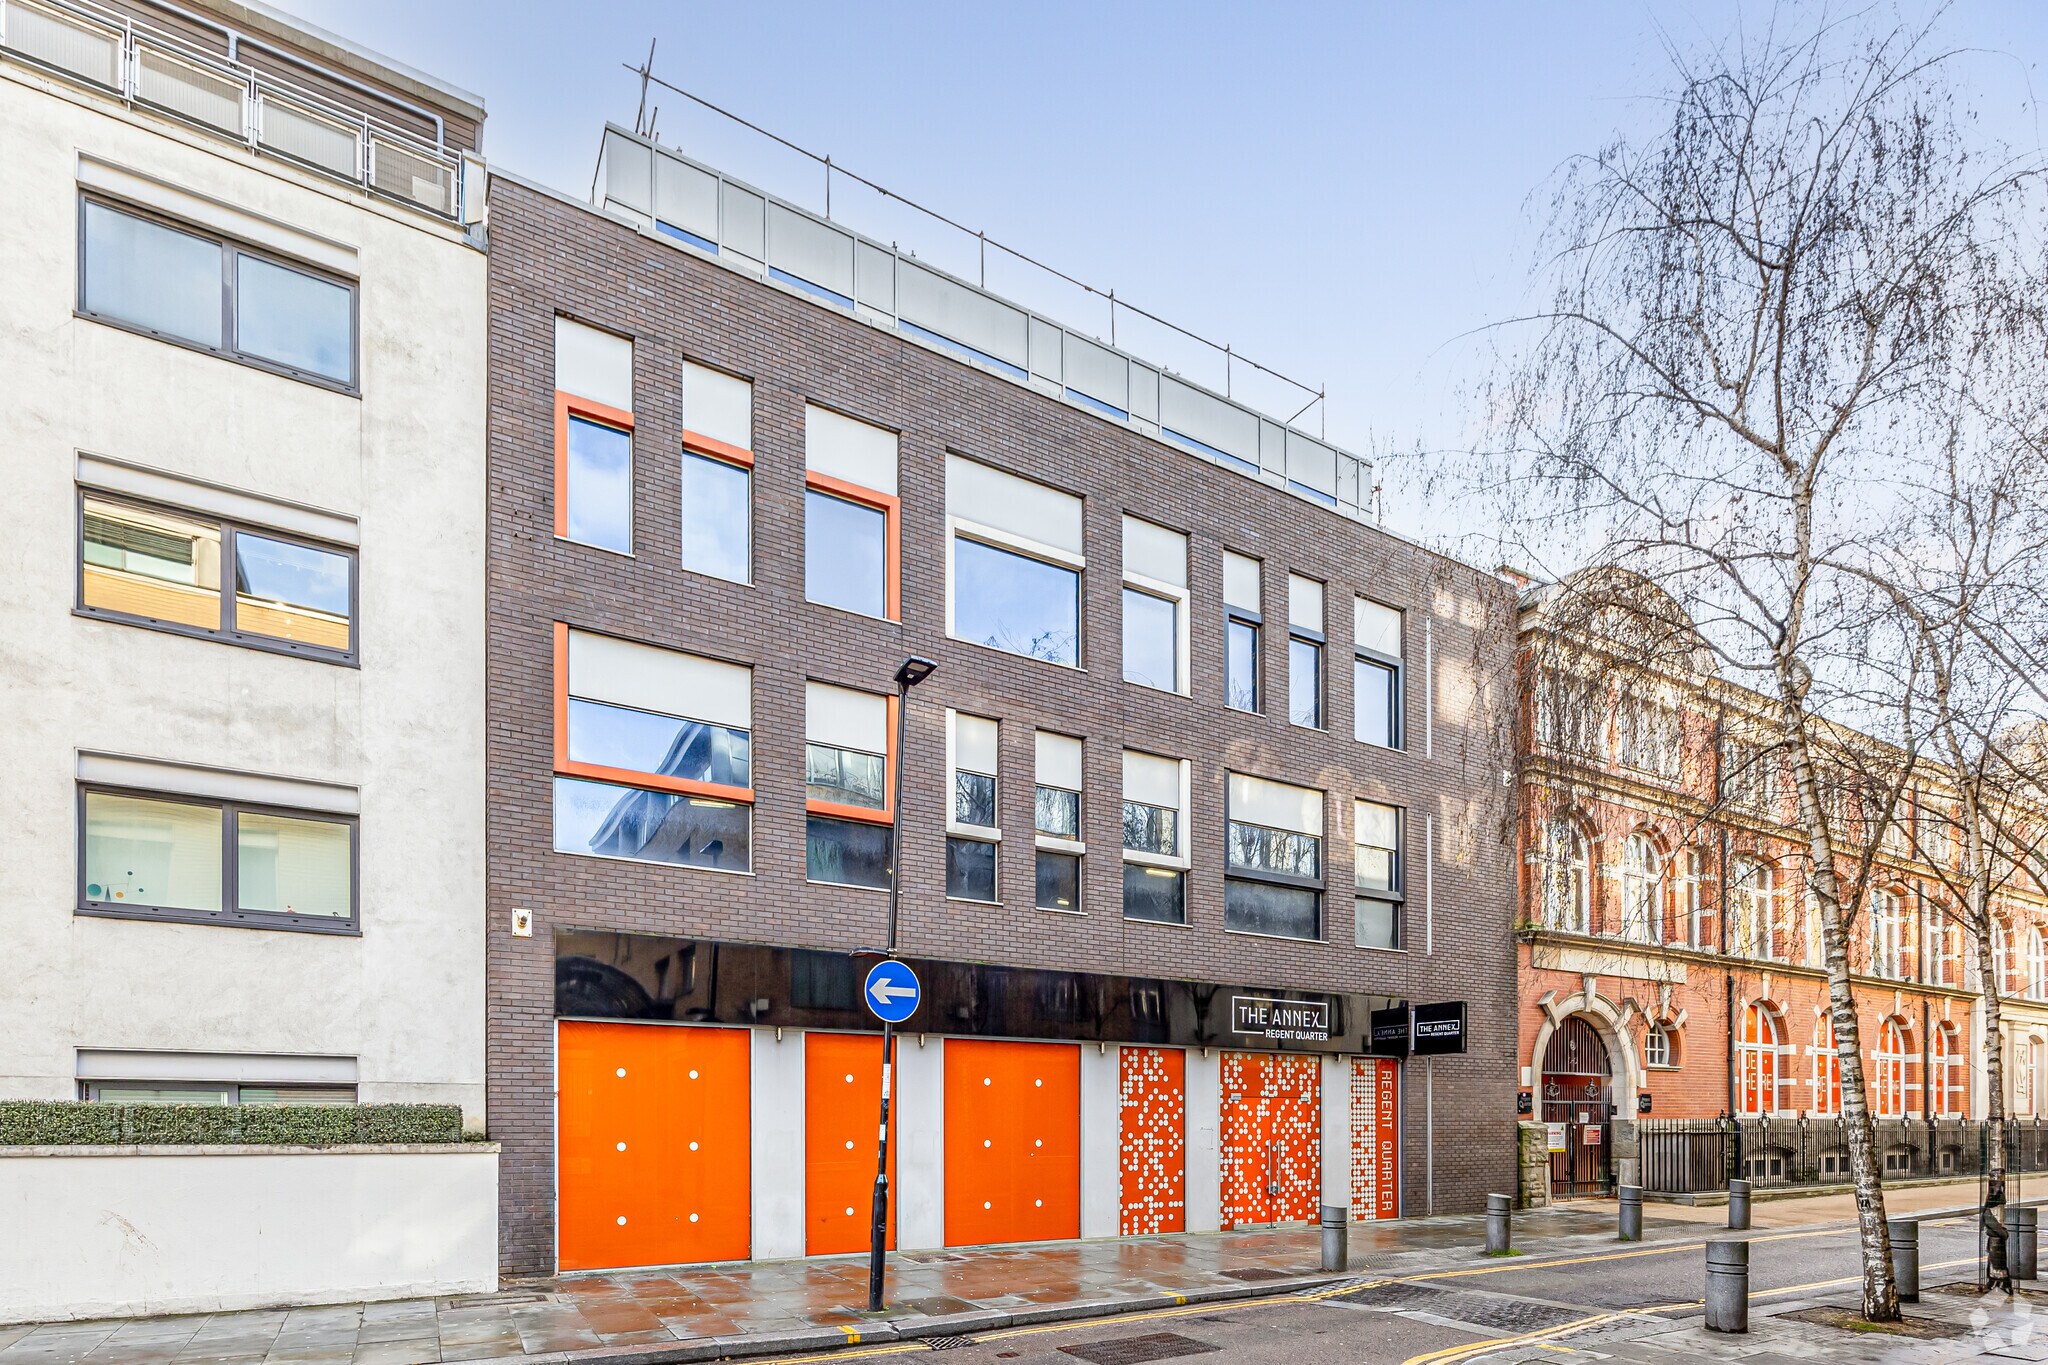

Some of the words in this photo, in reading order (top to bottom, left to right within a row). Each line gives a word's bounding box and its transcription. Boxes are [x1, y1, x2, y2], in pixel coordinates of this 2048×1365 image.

[1239, 1006, 1267, 1025] THE
[1272, 1009, 1320, 1028] ANNEX
[1420, 1025, 1433, 1033] THE
[1433, 1023, 1456, 1032] ANNEX
[1265, 1029, 1295, 1039] REGENT
[1295, 1030, 1328, 1041] QUARTER
[1381, 1070, 1393, 1130] REGENT
[1381, 1140, 1393, 1211] QUARTER
